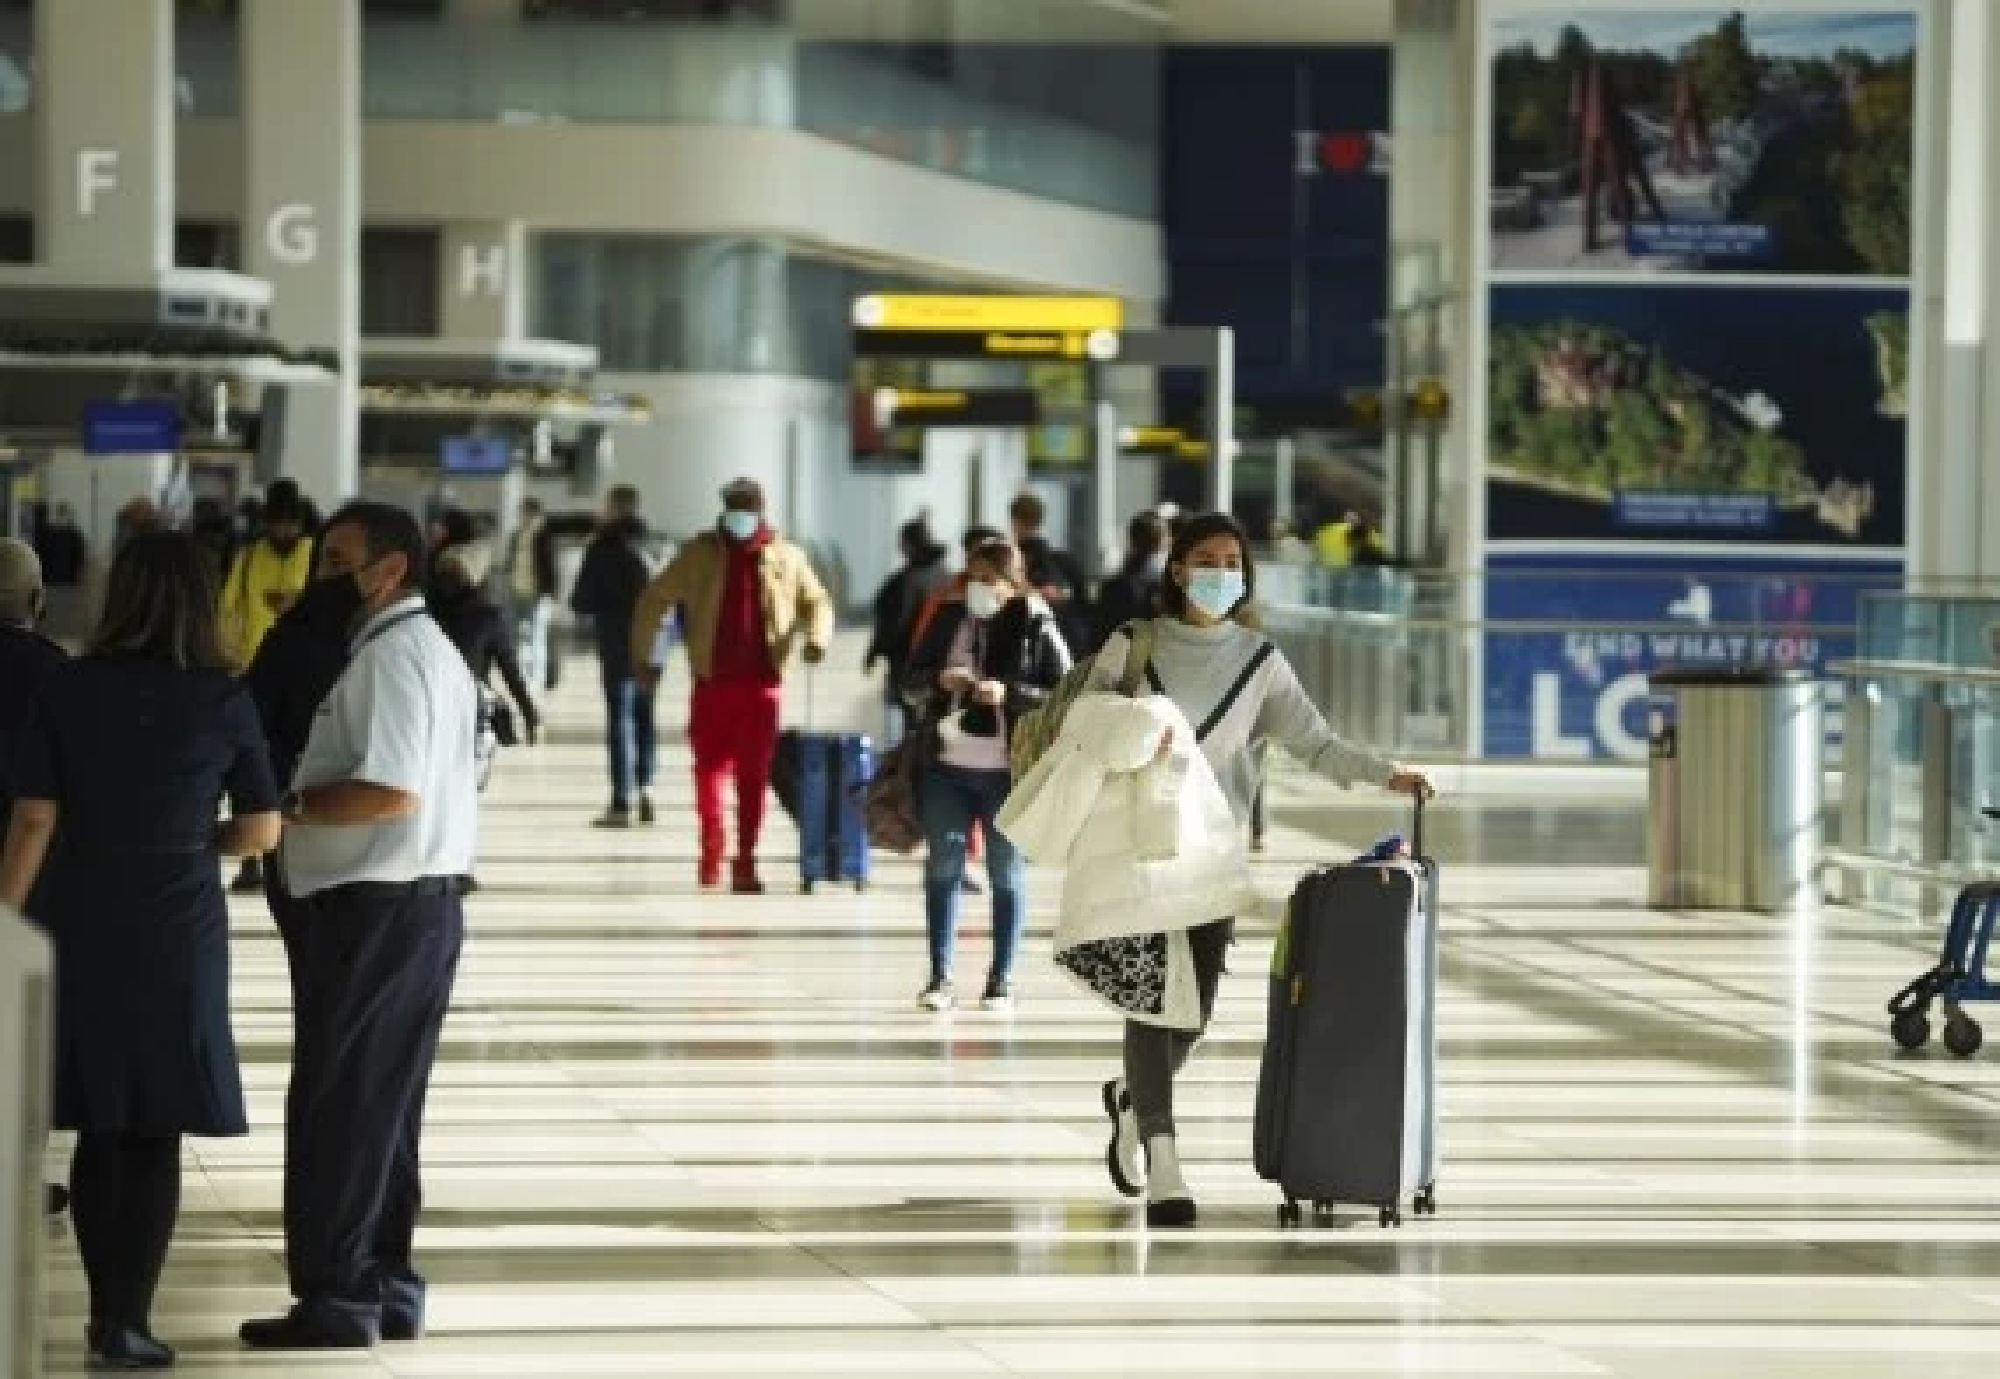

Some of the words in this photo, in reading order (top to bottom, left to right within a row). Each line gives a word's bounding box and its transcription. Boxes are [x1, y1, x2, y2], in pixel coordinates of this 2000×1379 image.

[77, 149, 119, 215] F
[266, 203, 319, 264] G
[458, 243, 506, 297] H
[1651, 634, 1747, 662] WHAT
[1756, 636, 1820, 664] YOU
